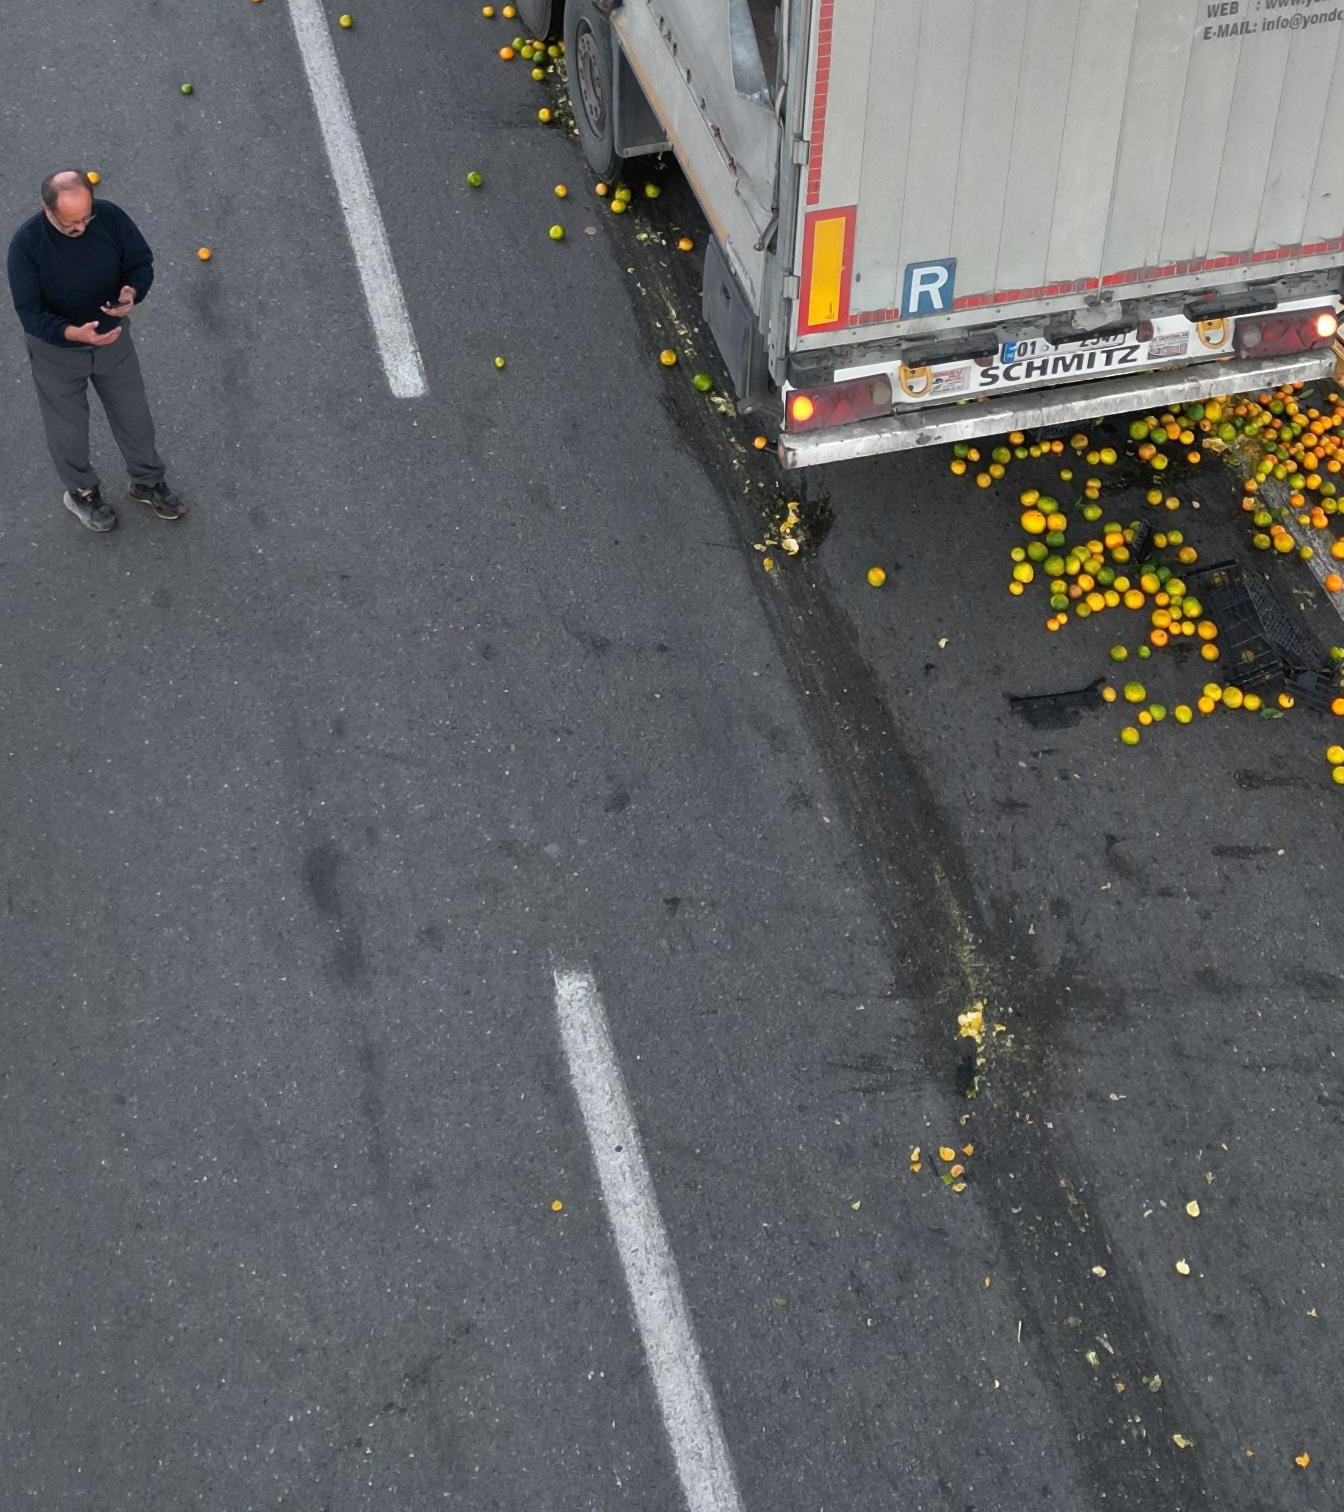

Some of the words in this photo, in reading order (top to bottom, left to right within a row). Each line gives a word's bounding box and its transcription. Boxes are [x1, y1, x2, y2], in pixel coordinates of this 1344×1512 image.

[1207, 1, 1239, 18] WEB
[909, 266, 948, 312] R
[1017, 340, 1037, 357] 01
[979, 344, 1141, 387] SCHMITZ
